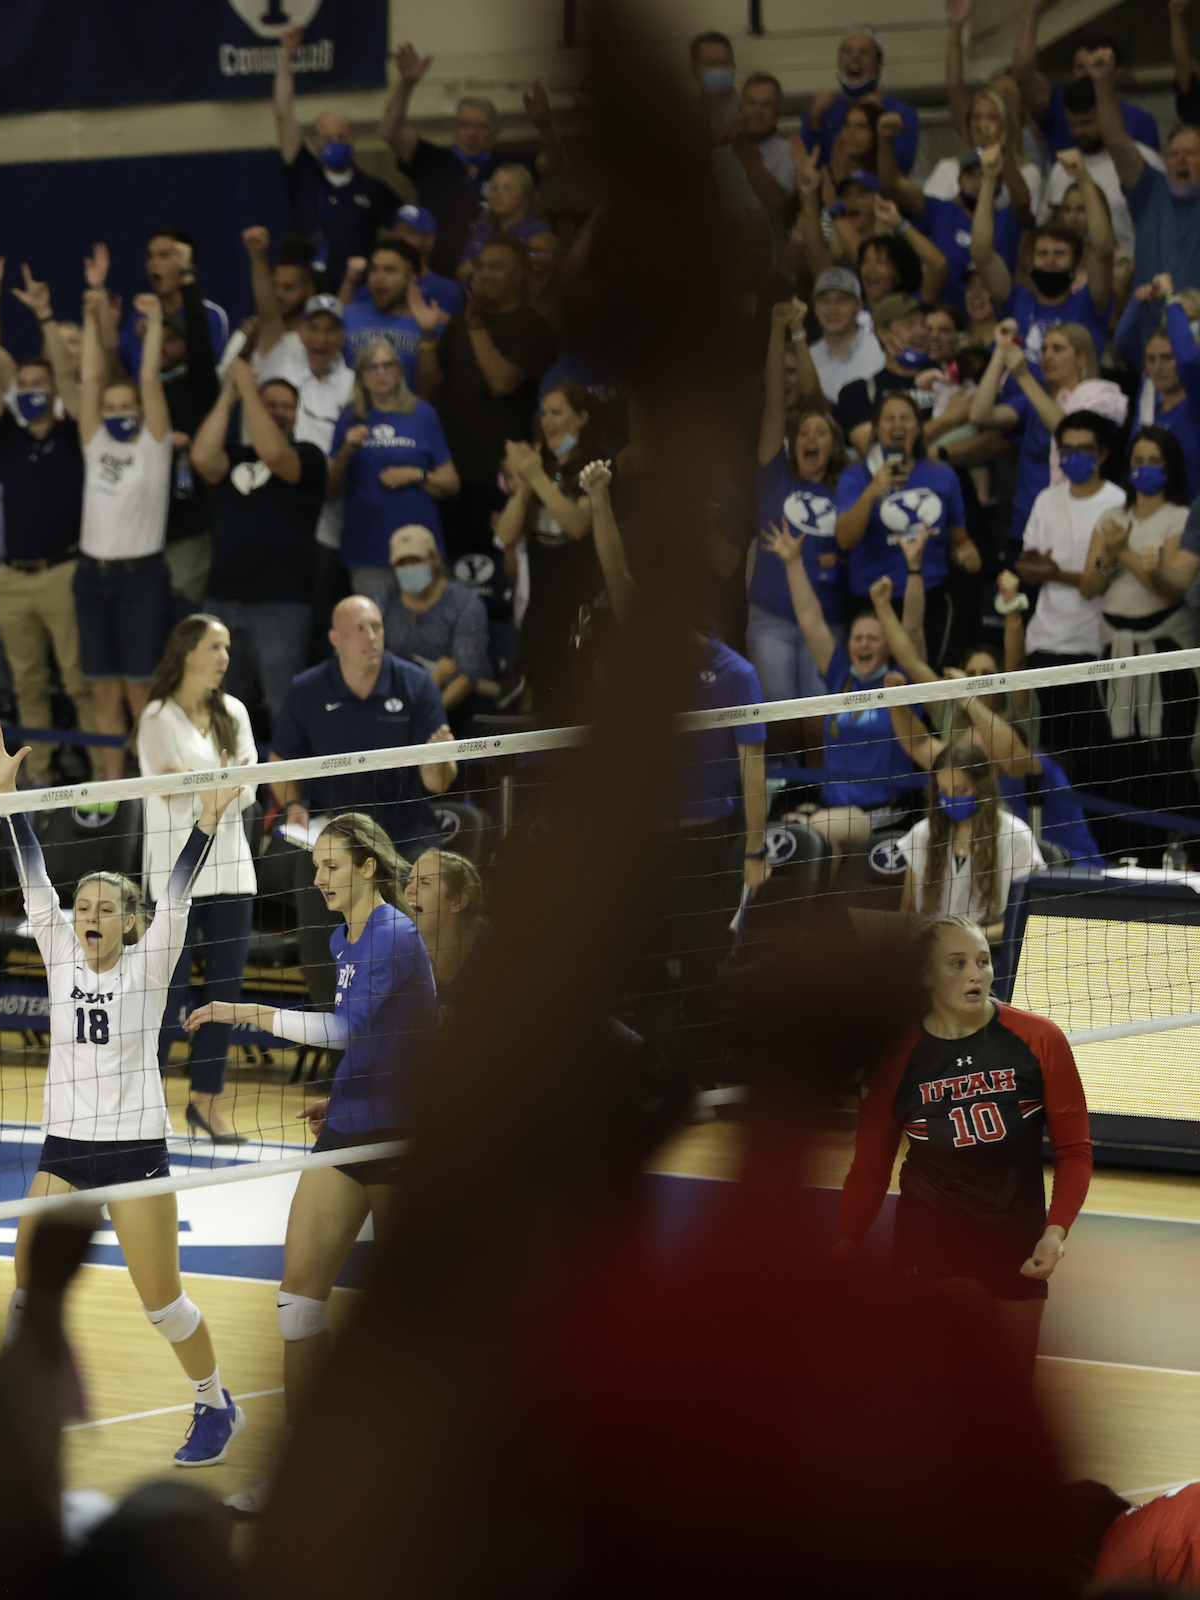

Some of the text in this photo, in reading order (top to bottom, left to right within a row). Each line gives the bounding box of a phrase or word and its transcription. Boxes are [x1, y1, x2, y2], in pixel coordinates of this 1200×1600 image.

[76, 1007, 109, 1044] 18
[919, 1068, 1016, 1104] UTAH
[948, 1102, 1007, 1147] 10
